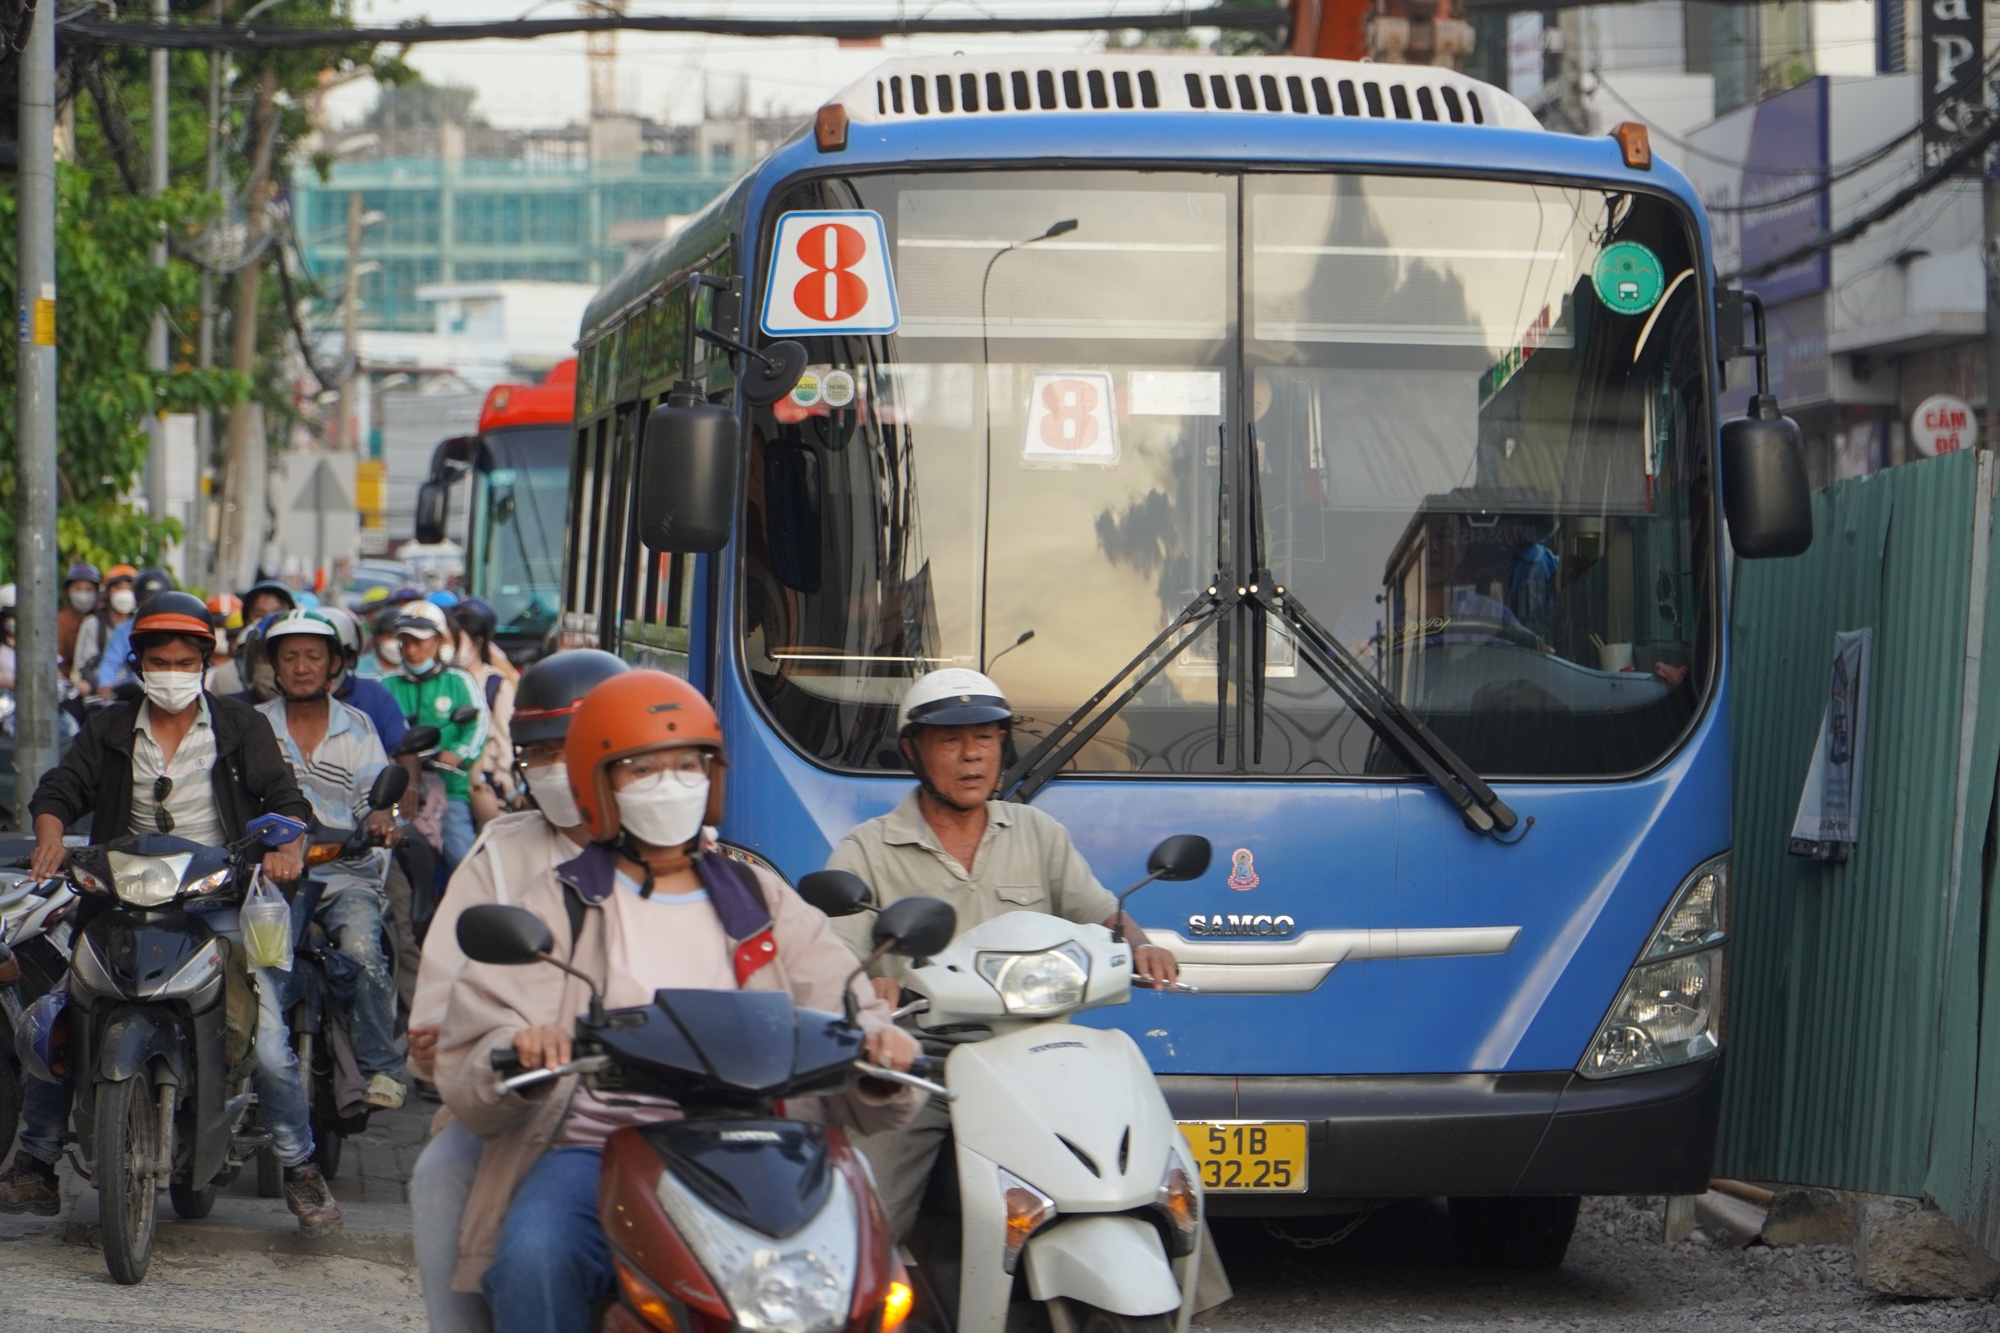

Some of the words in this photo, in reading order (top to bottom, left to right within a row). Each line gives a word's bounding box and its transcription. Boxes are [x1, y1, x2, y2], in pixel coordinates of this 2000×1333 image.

[794, 223, 868, 322] 8
[1040, 379, 1099, 450] 8
[1189, 915, 1294, 936] SAMCO
[1209, 1128, 1267, 1155] 51B
